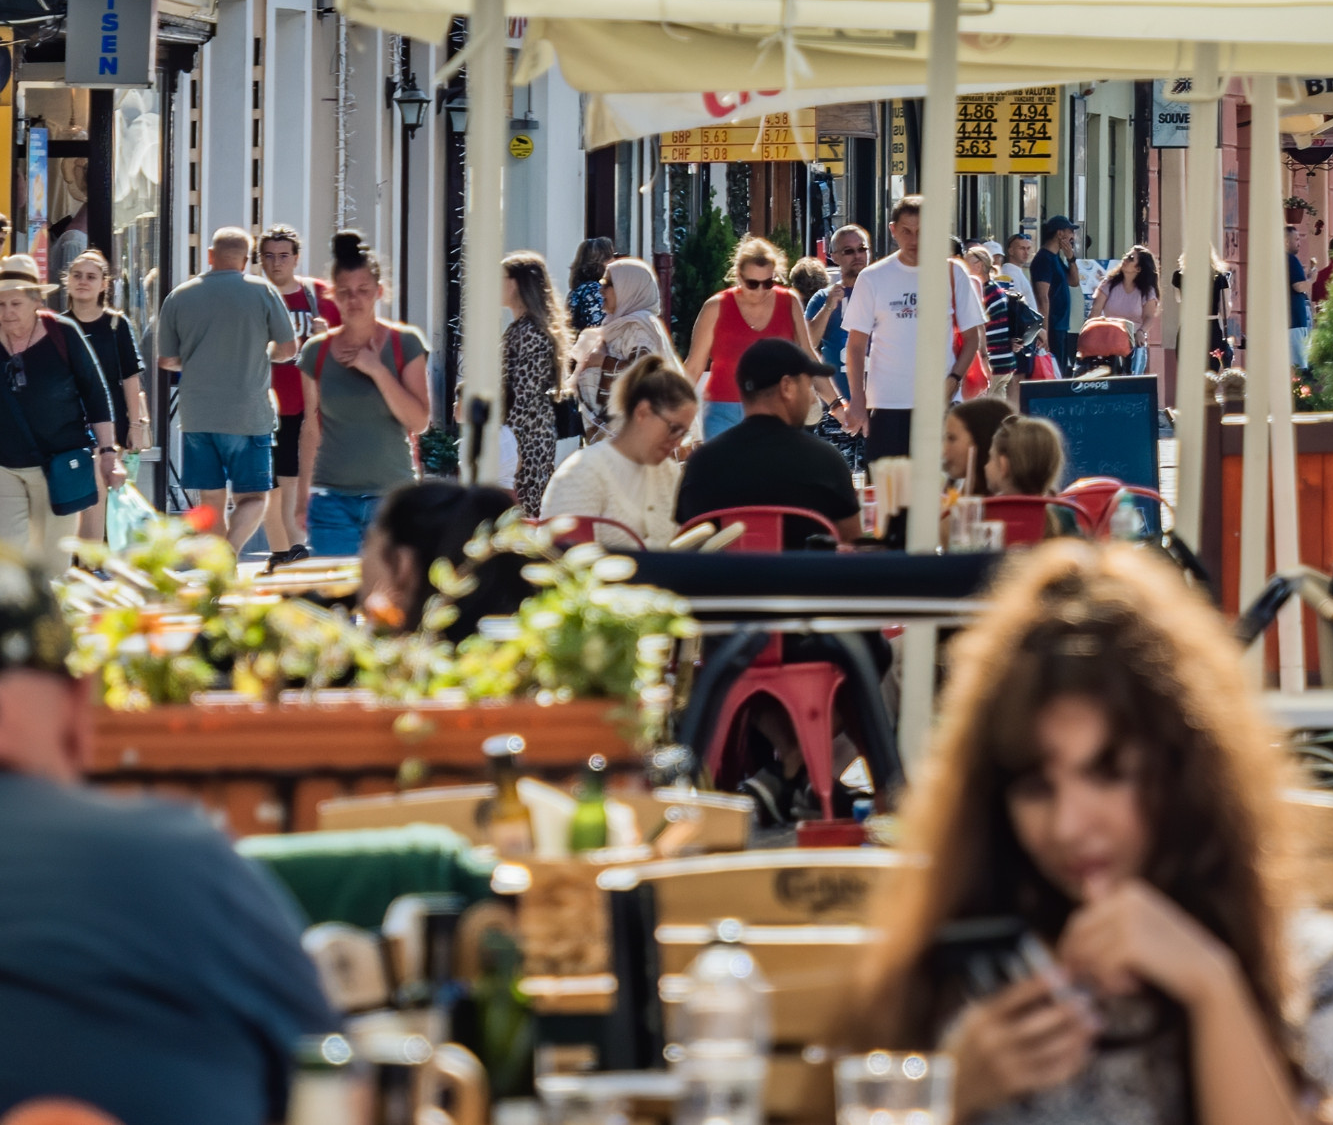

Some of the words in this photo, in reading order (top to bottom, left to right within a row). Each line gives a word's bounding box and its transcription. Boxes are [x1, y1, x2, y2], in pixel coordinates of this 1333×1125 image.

[1024, 87, 1056, 96] VALUTAR
[959, 104, 995, 119] 4,86
[1013, 104, 1048, 120] 4,94
[1158, 113, 1191, 124] SOUVE
[957, 122, 994, 137] 4,44
[1010, 122, 1048, 137] 4,54
[672, 131, 691, 144] GBP
[672, 148, 690, 161] CHF
[956, 139, 991, 155] 5,63
[1011, 139, 1036, 155] 5,7
[1083, 381, 1109, 390] pepsi
